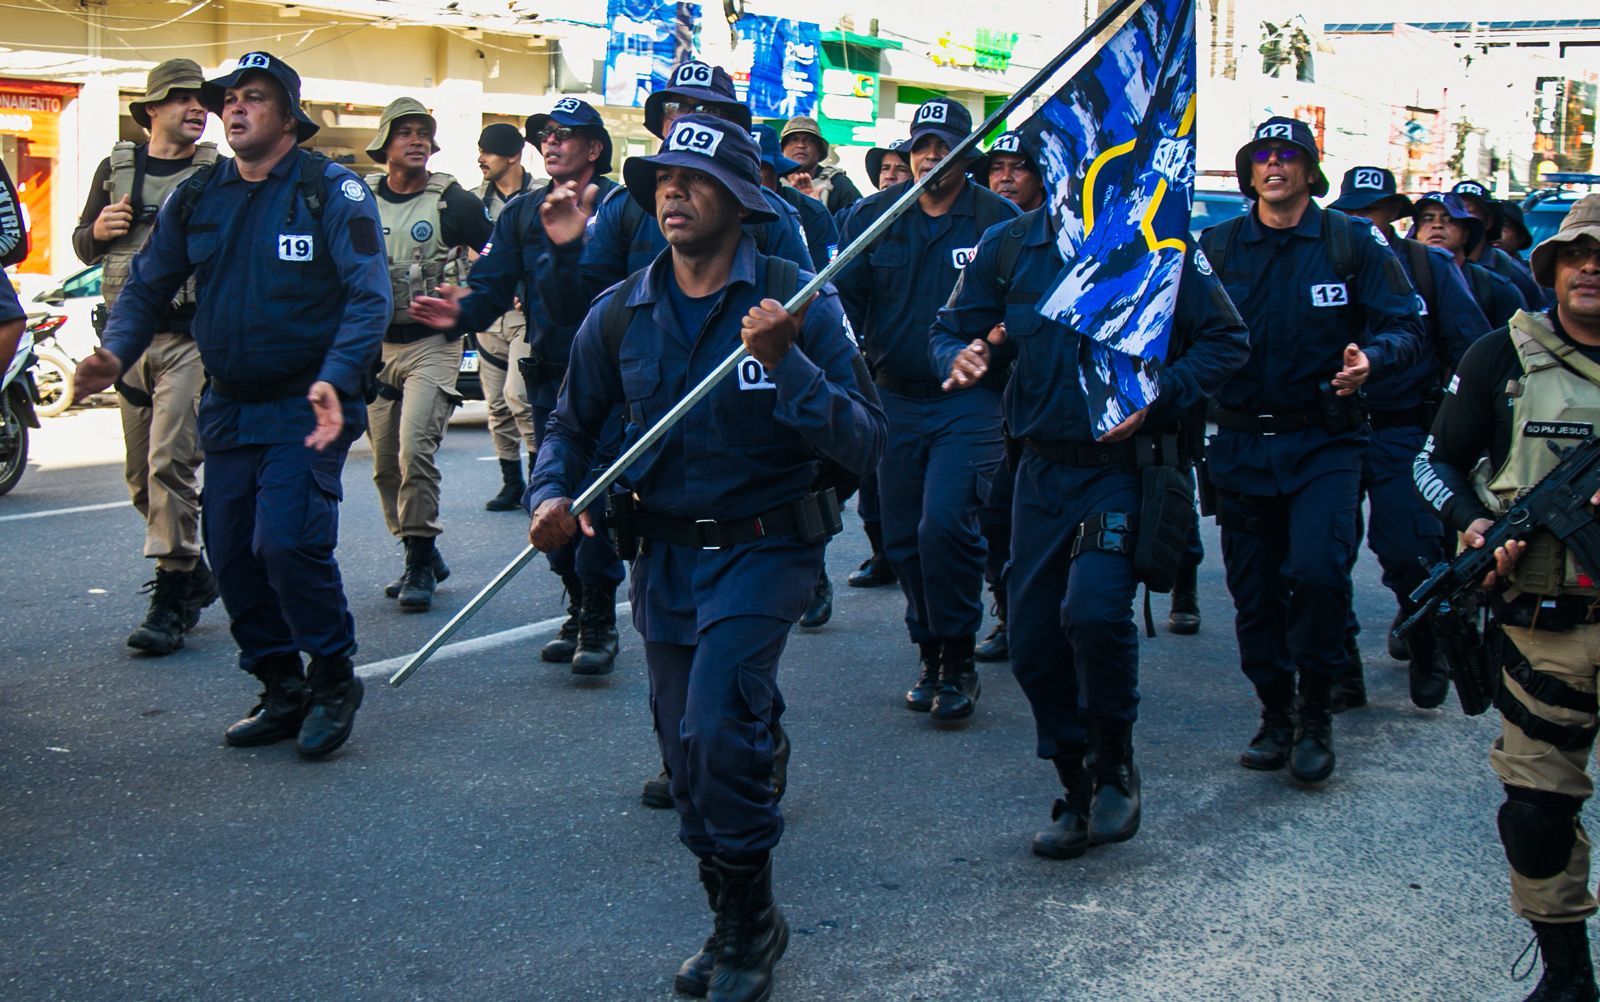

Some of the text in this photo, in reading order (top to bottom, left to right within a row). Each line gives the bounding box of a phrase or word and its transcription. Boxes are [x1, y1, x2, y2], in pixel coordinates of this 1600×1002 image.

[680, 66, 709, 82] 06
[0, 94, 61, 112] NAMENTO
[554, 99, 578, 110] 23
[921, 105, 944, 119] 08
[676, 127, 714, 149] 09
[1262, 126, 1289, 138] 12
[1358, 172, 1381, 186] 20
[282, 239, 310, 257] 19
[1317, 287, 1345, 303] 12
[742, 360, 775, 384] 0
[1557, 426, 1589, 435] JESUS
